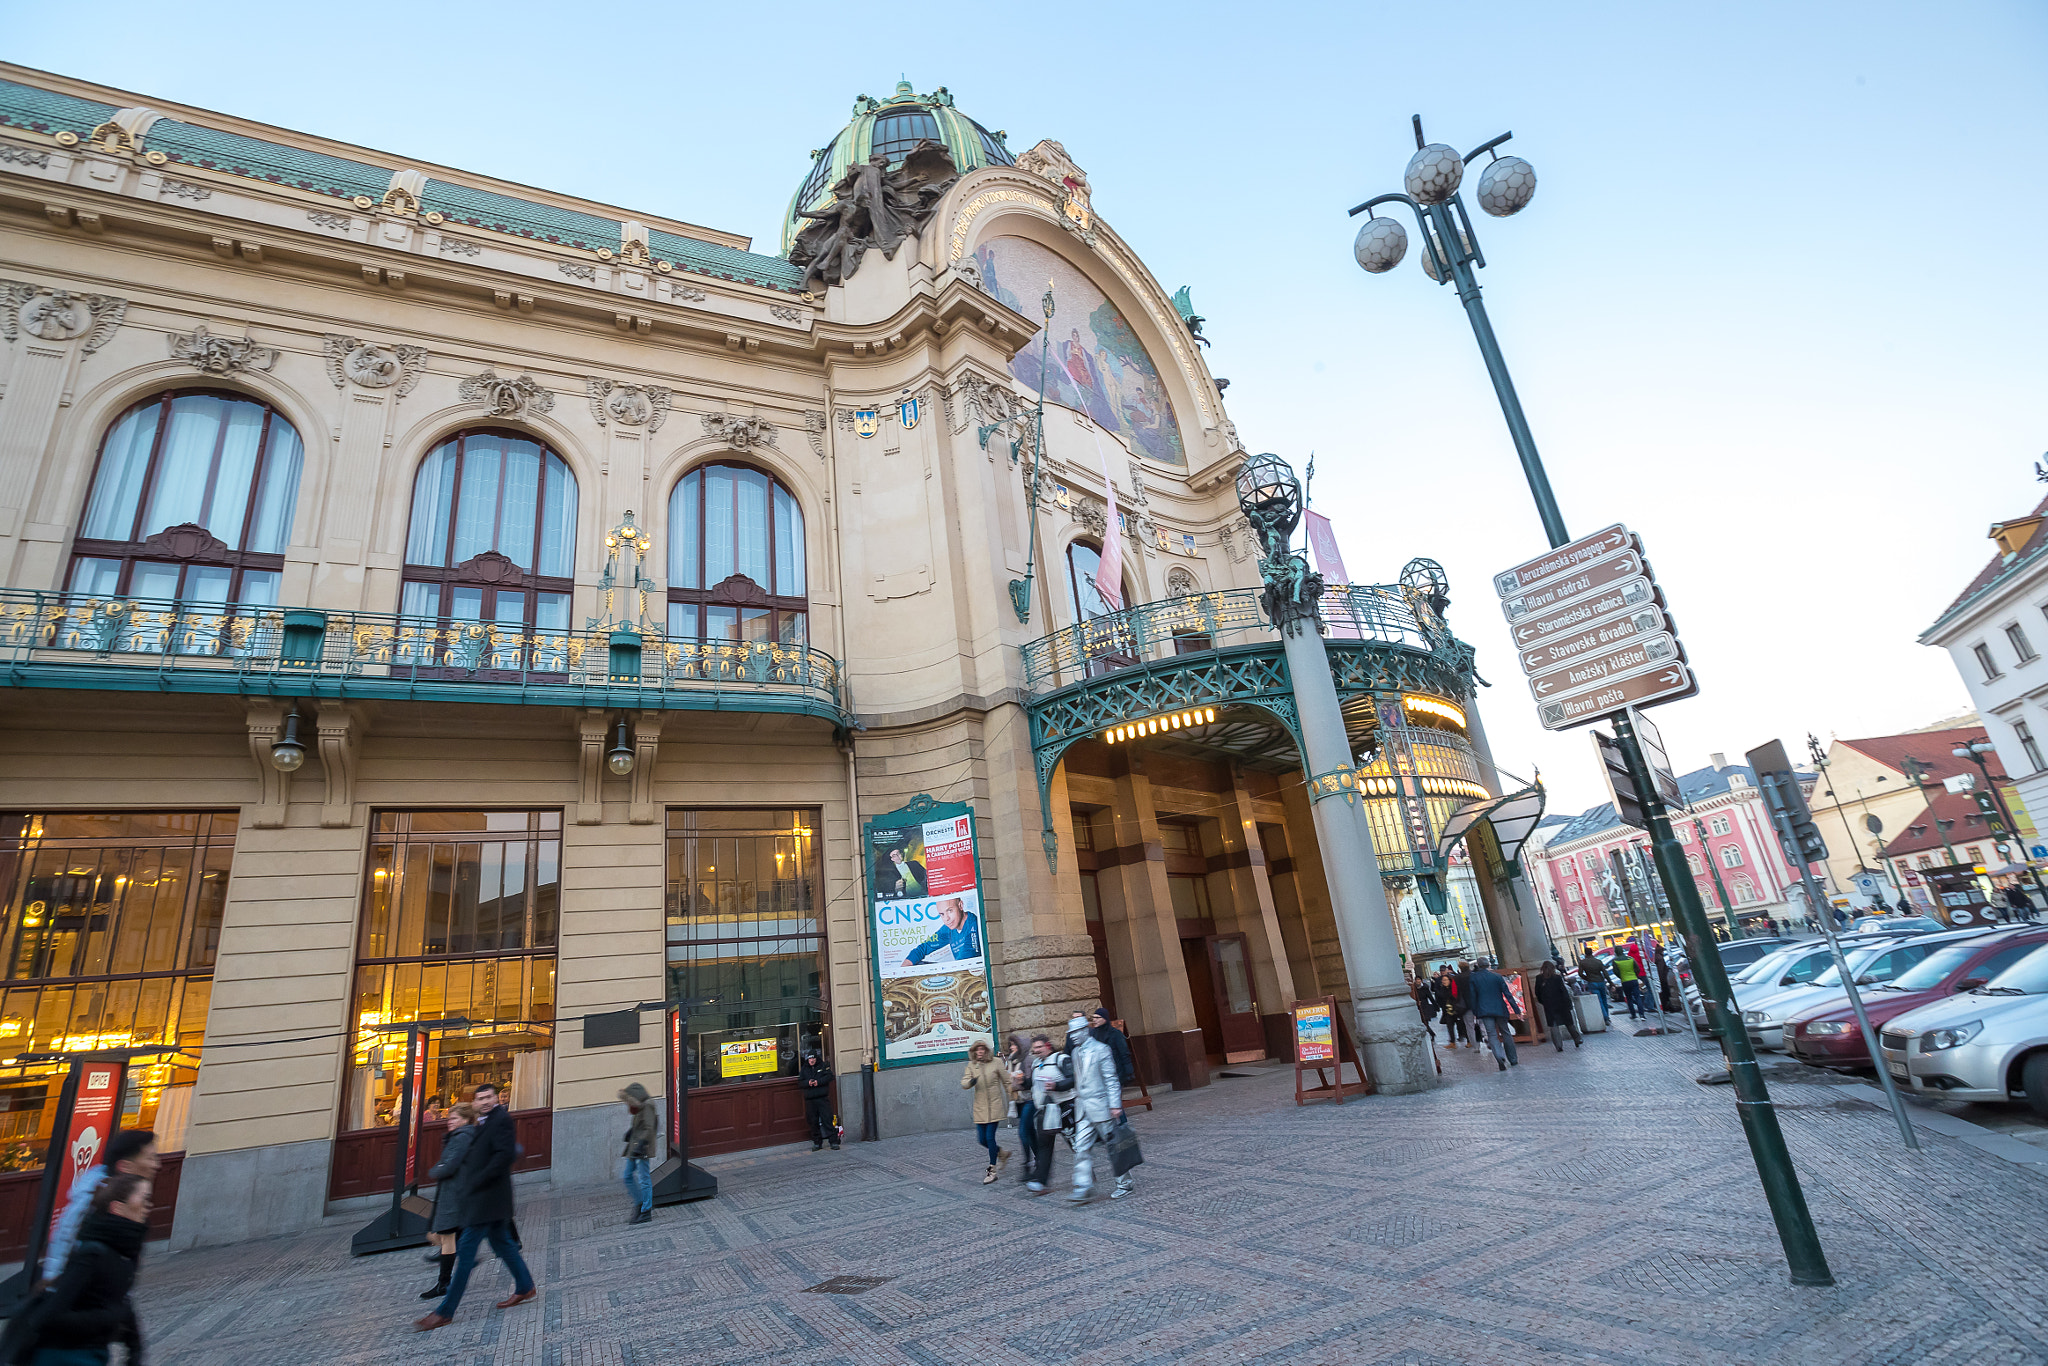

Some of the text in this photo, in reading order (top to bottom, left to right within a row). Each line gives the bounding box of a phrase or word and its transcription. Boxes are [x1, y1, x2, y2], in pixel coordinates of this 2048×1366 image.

[1520, 541, 1606, 583] Jeruzalémská synagoga
[1527, 575, 1591, 610] Hlavní nádraží
[1537, 594, 1624, 634] Staroměstská radnice
[1549, 620, 1634, 660] Stavovské divadlo
[1568, 649, 1645, 684] Anežský klášter
[1564, 688, 1625, 716] Hlavní pošta
[925, 826, 954, 837] ORCHESTR
[926, 844, 948, 854] HARRY
[948, 839, 971, 850] POTTER
[882, 925, 928, 939] STEWART
[883, 933, 940, 947] GOODYEAR
[1298, 1007, 1327, 1015] CONCERTS
